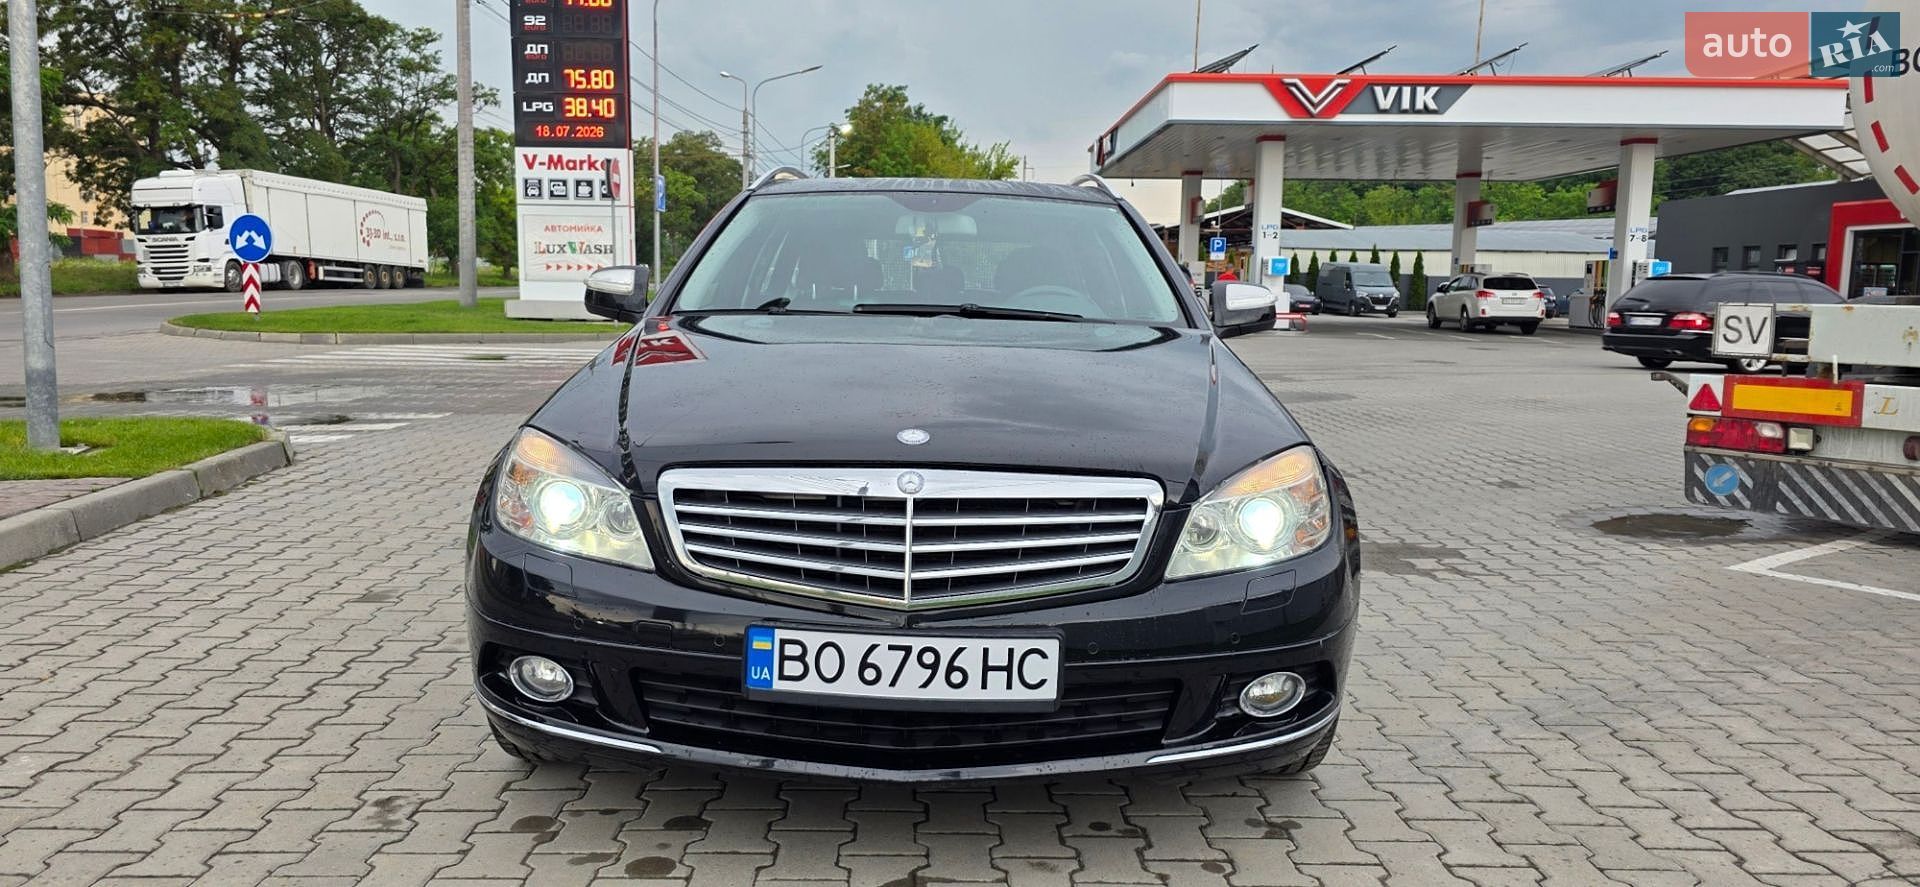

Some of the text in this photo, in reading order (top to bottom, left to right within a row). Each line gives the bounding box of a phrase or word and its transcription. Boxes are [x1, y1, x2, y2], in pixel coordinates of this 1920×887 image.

[523, 15, 547, 26] 92
[524, 43, 549, 55] ДП
[524, 69, 615, 90] ДП 75.80
[522, 97, 616, 118] LPG 38.40
[1373, 86, 1440, 113] VIK
[535, 125, 604, 138] 18.07.2026
[543, 223, 604, 233] АВТОМИЙКА
[1214, 239, 1222, 252] P
[1722, 315, 1768, 345] SV
[777, 637, 1050, 691] BO 6796 HC
[750, 665, 771, 681] UA
